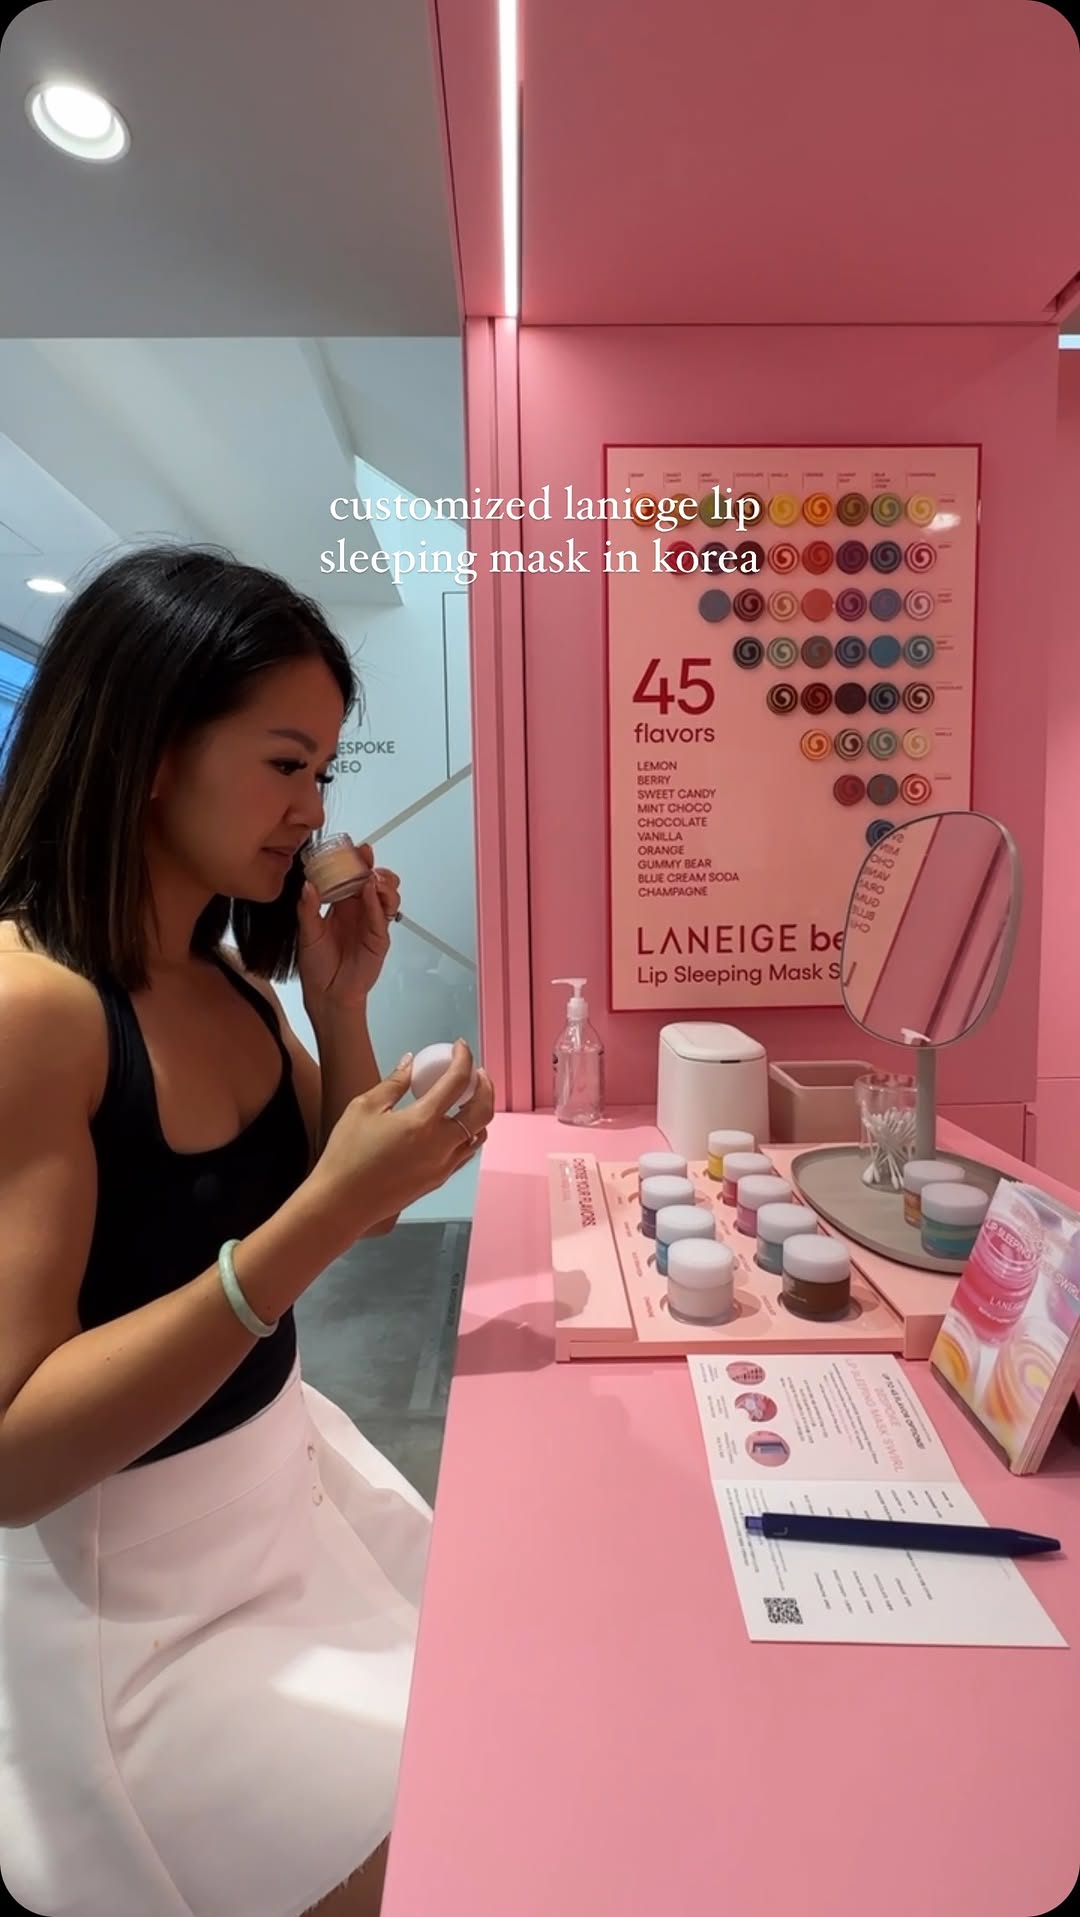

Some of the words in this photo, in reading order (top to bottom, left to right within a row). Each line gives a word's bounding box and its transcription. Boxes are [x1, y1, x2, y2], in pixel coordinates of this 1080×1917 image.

[632, 658, 715, 716] 45
[634, 722, 716, 744] flavors
[336, 740, 396, 755] ESPOKE
[636, 760, 678, 772] LEMON
[636, 774, 671, 786] BERRY
[637, 788, 674, 800] SWEET
[677, 788, 717, 800] CANDY
[637, 802, 665, 814] MINT
[667, 801, 713, 814] CHOCO
[637, 816, 708, 828] CHOCOLATE
[637, 831, 683, 842] VANILLA
[637, 845, 685, 856] ORANGE
[637, 859, 682, 870] GUMMY
[684, 858, 713, 869] BEAR
[637, 873, 665, 884] BLUE
[666, 872, 707, 883] CREAM
[708, 871, 740, 883] SODA
[637, 886, 709, 898] CHAMPAGNE
[637, 923, 798, 955] LANEIGE
[637, 965, 668, 988] Lip
[673, 964, 762, 987] Sleeping
[769, 963, 823, 982] Mask
[828, 962, 843, 980] S
